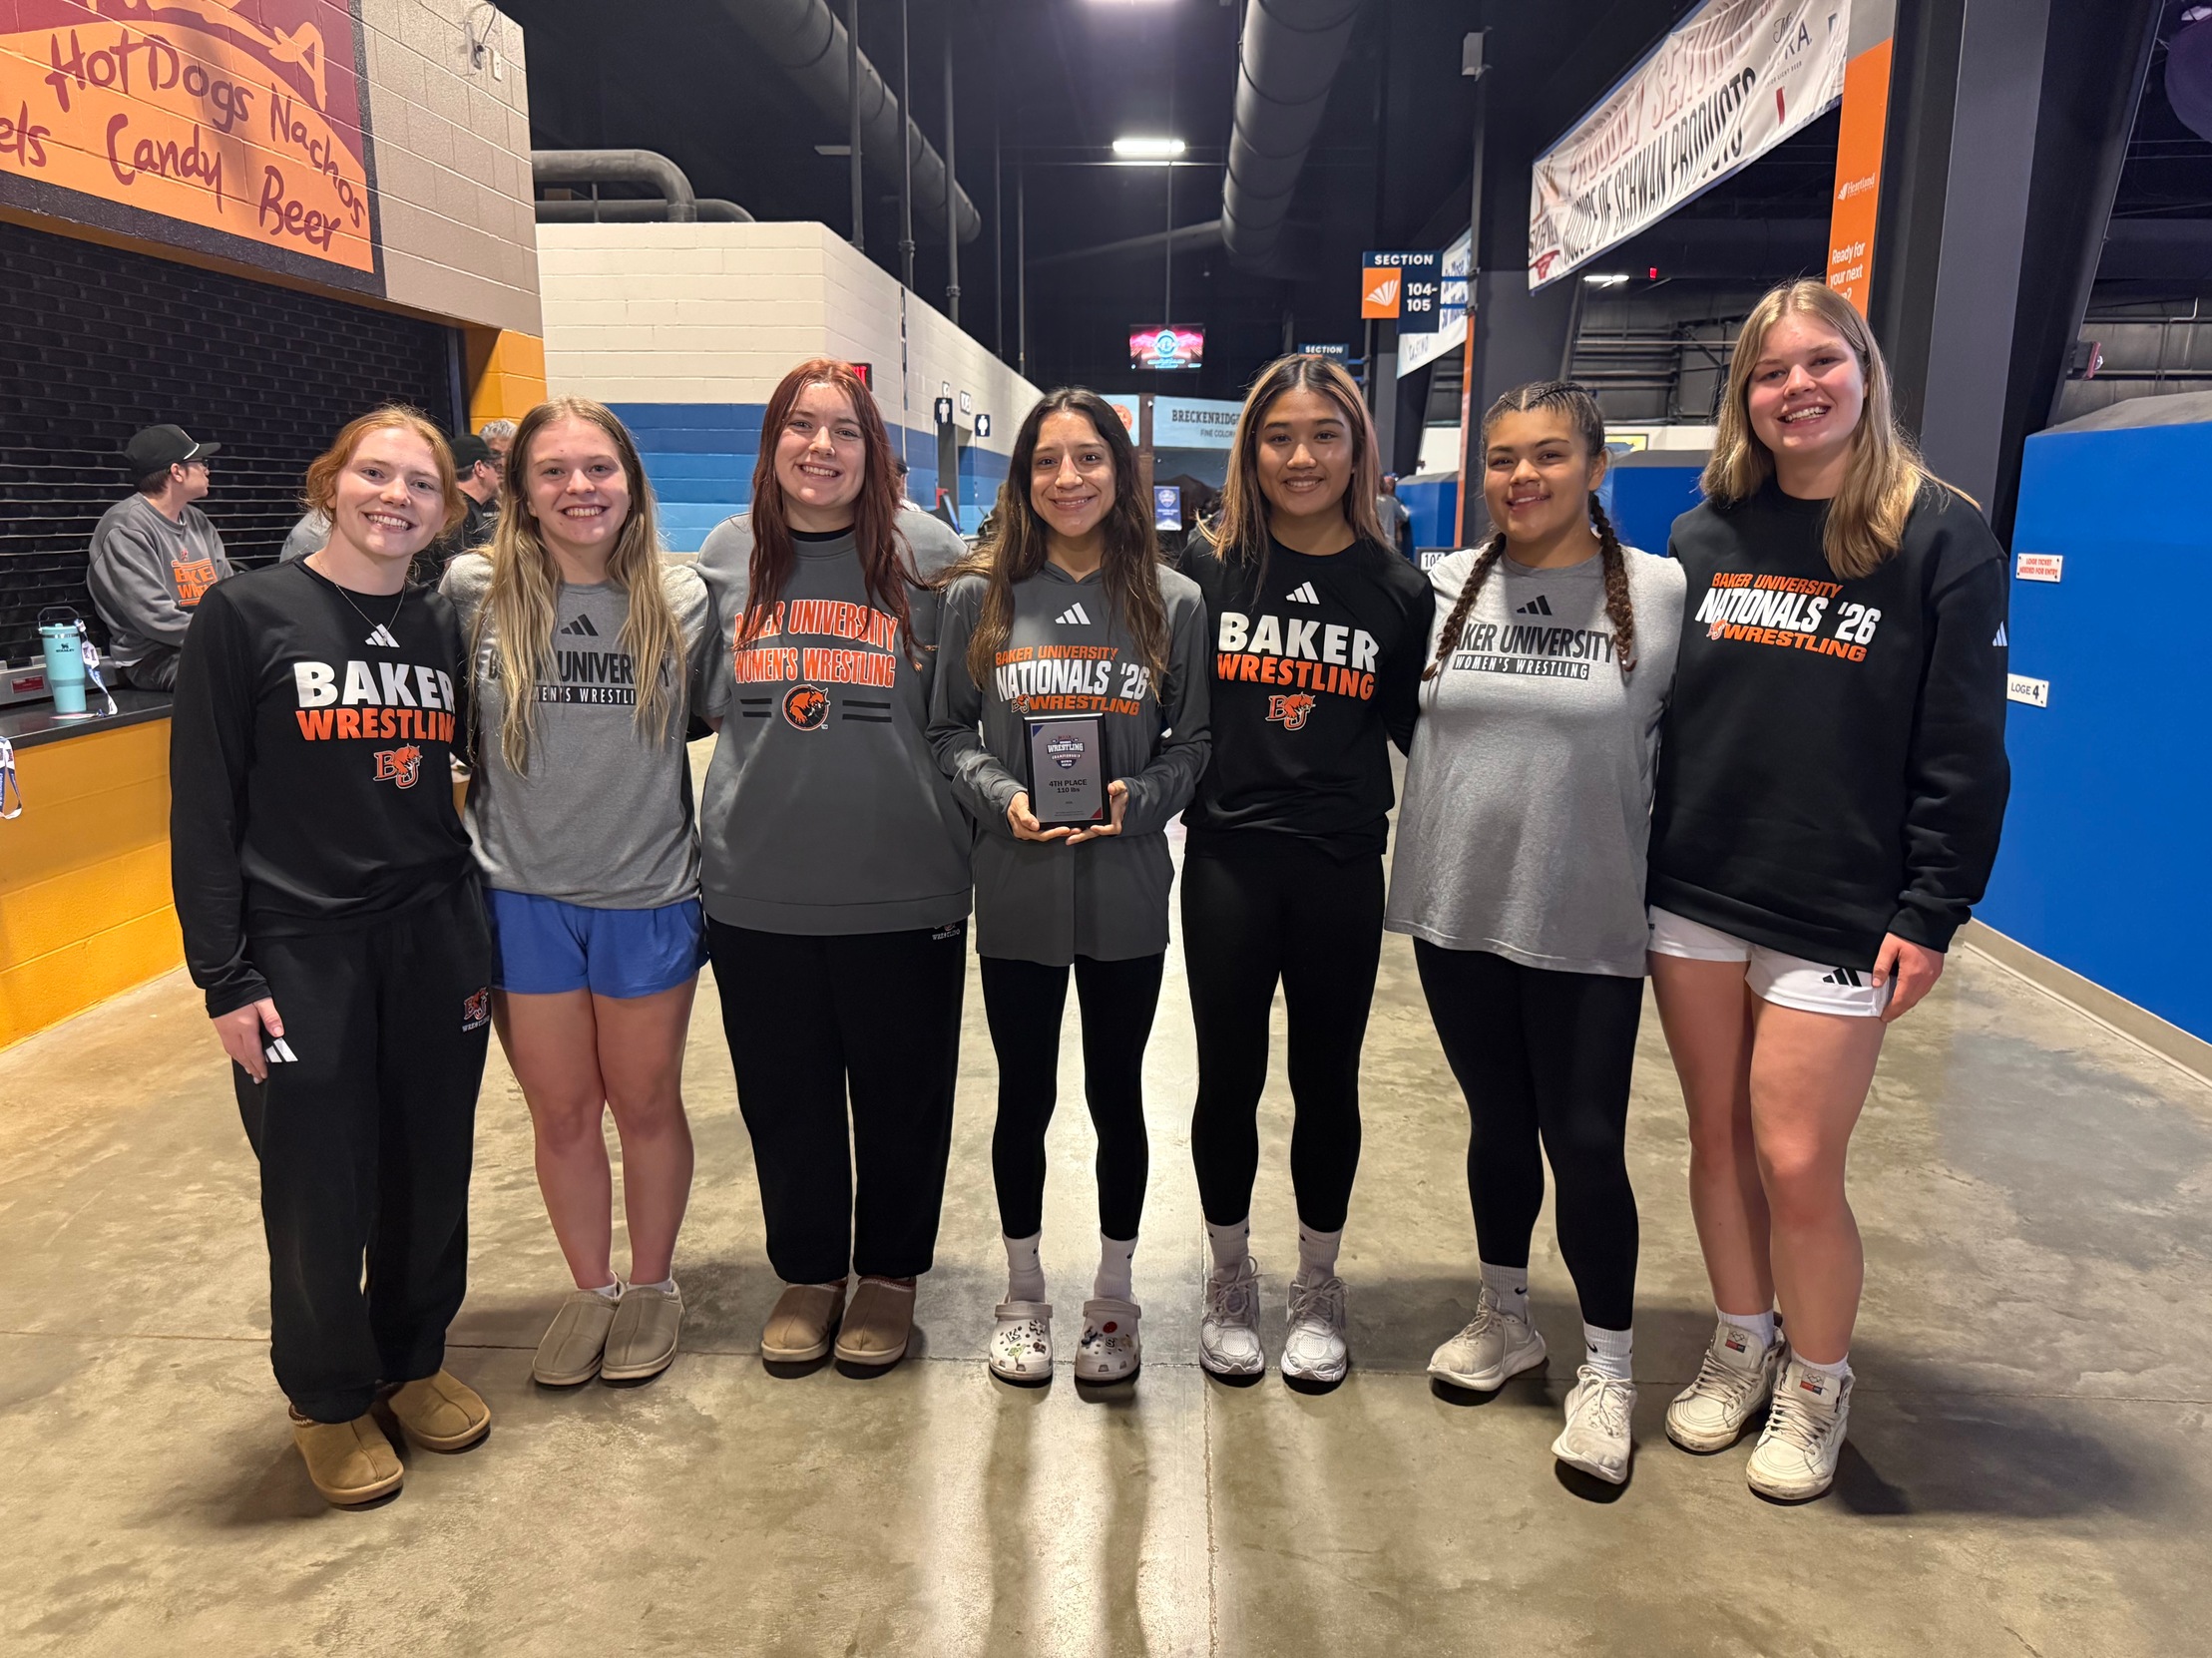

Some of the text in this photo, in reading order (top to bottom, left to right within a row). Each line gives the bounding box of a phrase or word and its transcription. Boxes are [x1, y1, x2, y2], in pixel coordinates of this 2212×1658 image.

[44, 29, 366, 229] Hot Dogs Nachos
[106, 113, 223, 212] Candy
[258, 166, 342, 251] Beer
[1374, 253, 1434, 265] SECTION
[1832, 240, 1866, 266] Ready for
[1407, 282, 1439, 296] 104-
[1830, 263, 1864, 289] your next
[1407, 298, 1432, 312] 105
[1305, 345, 1343, 354] SECTION
[1711, 572, 1844, 599] BAKER UNIVERSITY
[788, 600, 898, 652] UNIVERSITY
[1694, 587, 1882, 645] NATIONALS '26
[1218, 612, 1380, 673] BAKER
[1500, 624, 1617, 663] UNIVERSITY
[1724, 622, 1868, 662] WRESTLING
[734, 647, 897, 688] WOMEN'S WRESTLING
[996, 645, 1119, 666] BAKER UNIVERSITY
[1455, 655, 1588, 679] WOMEN'S WRESTLING
[995, 658, 1150, 702] NATIONALS '26
[1217, 653, 1375, 700] WRESTLING
[2010, 682, 2039, 699] LOGE 4
[1029, 695, 1140, 716] WRESTLING
[1048, 742, 1084, 753] WRESTLING
